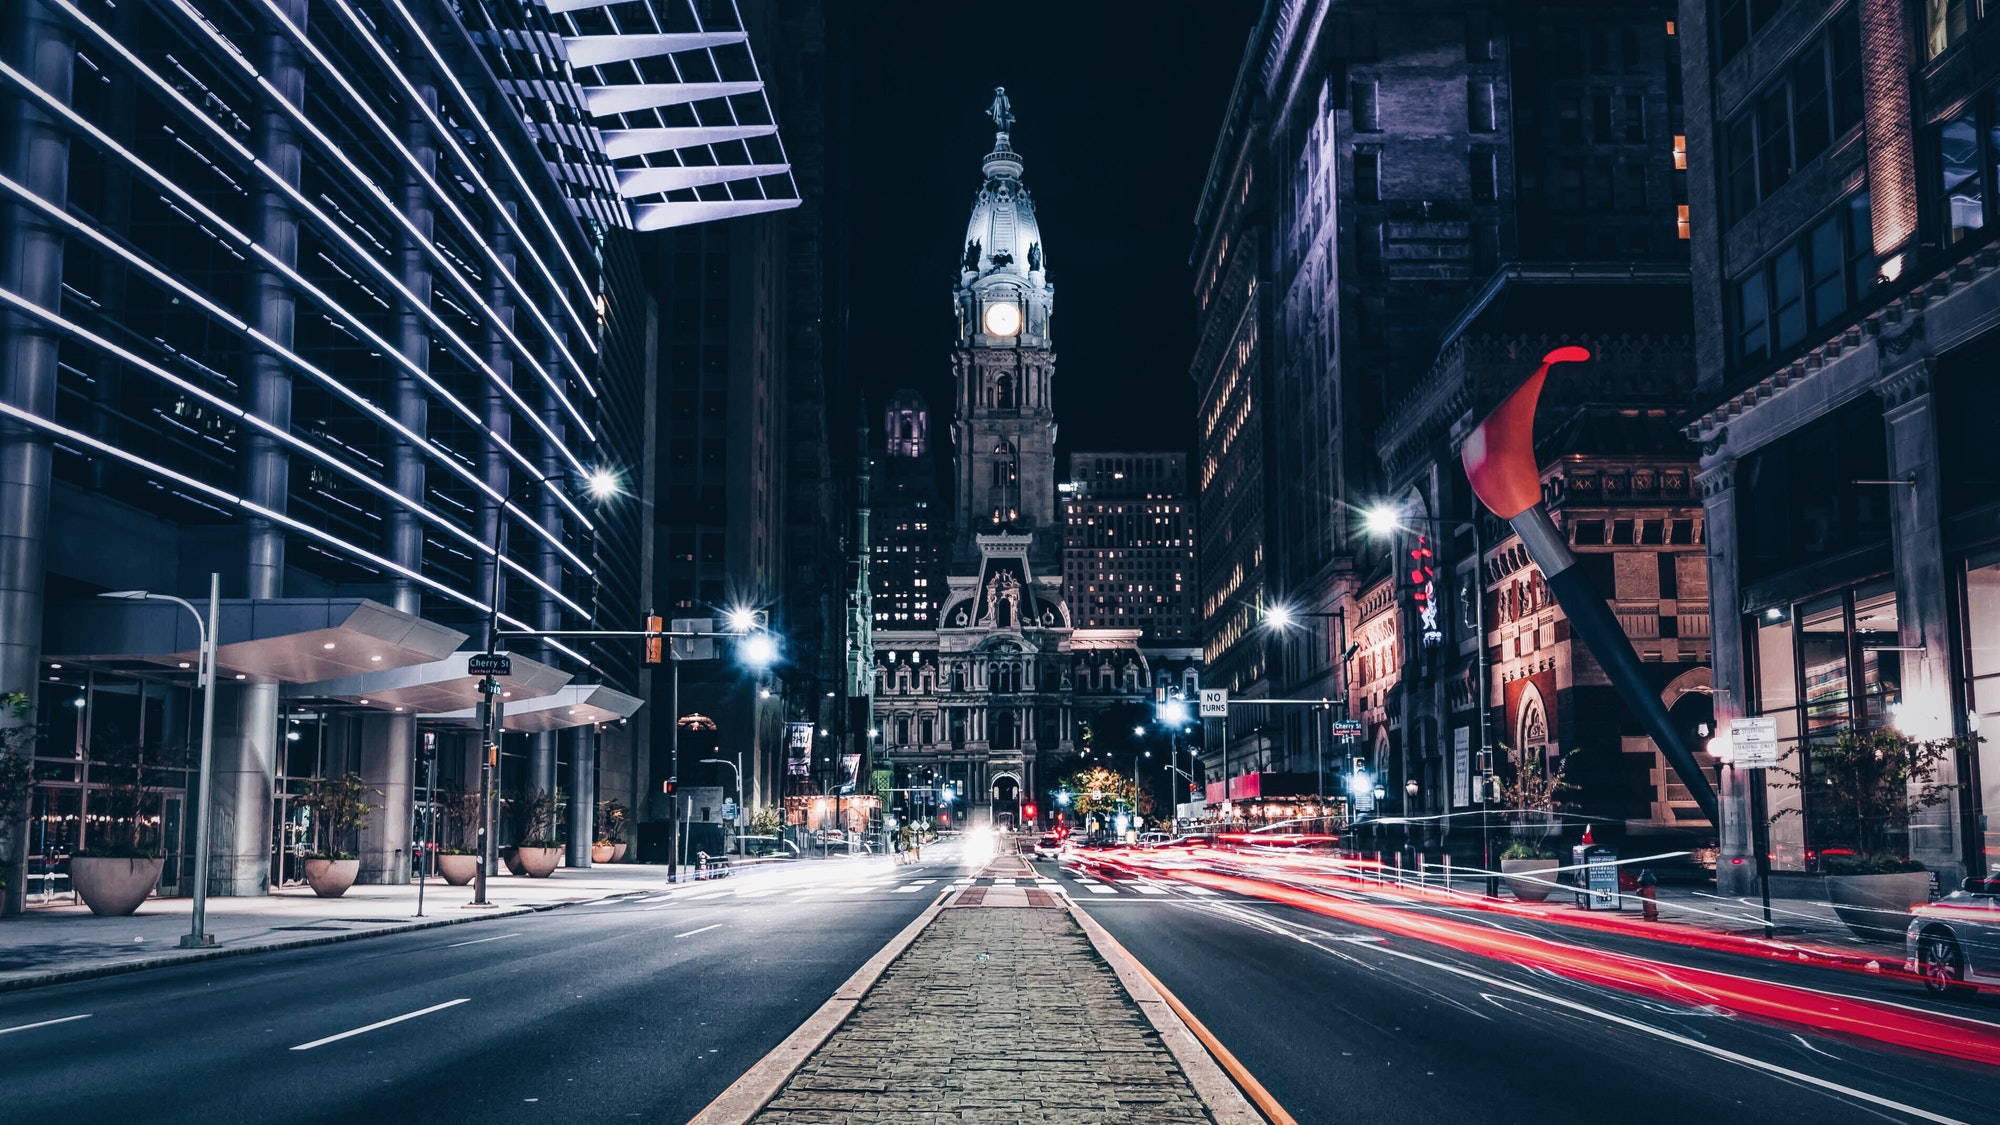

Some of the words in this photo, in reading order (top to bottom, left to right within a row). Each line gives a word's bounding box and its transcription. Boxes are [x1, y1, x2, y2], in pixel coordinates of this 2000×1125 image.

[470, 658, 498, 668] Cherry
[501, 660, 509, 668] St
[1206, 693, 1221, 702] NO
[1202, 704, 1225, 712] TURNS
